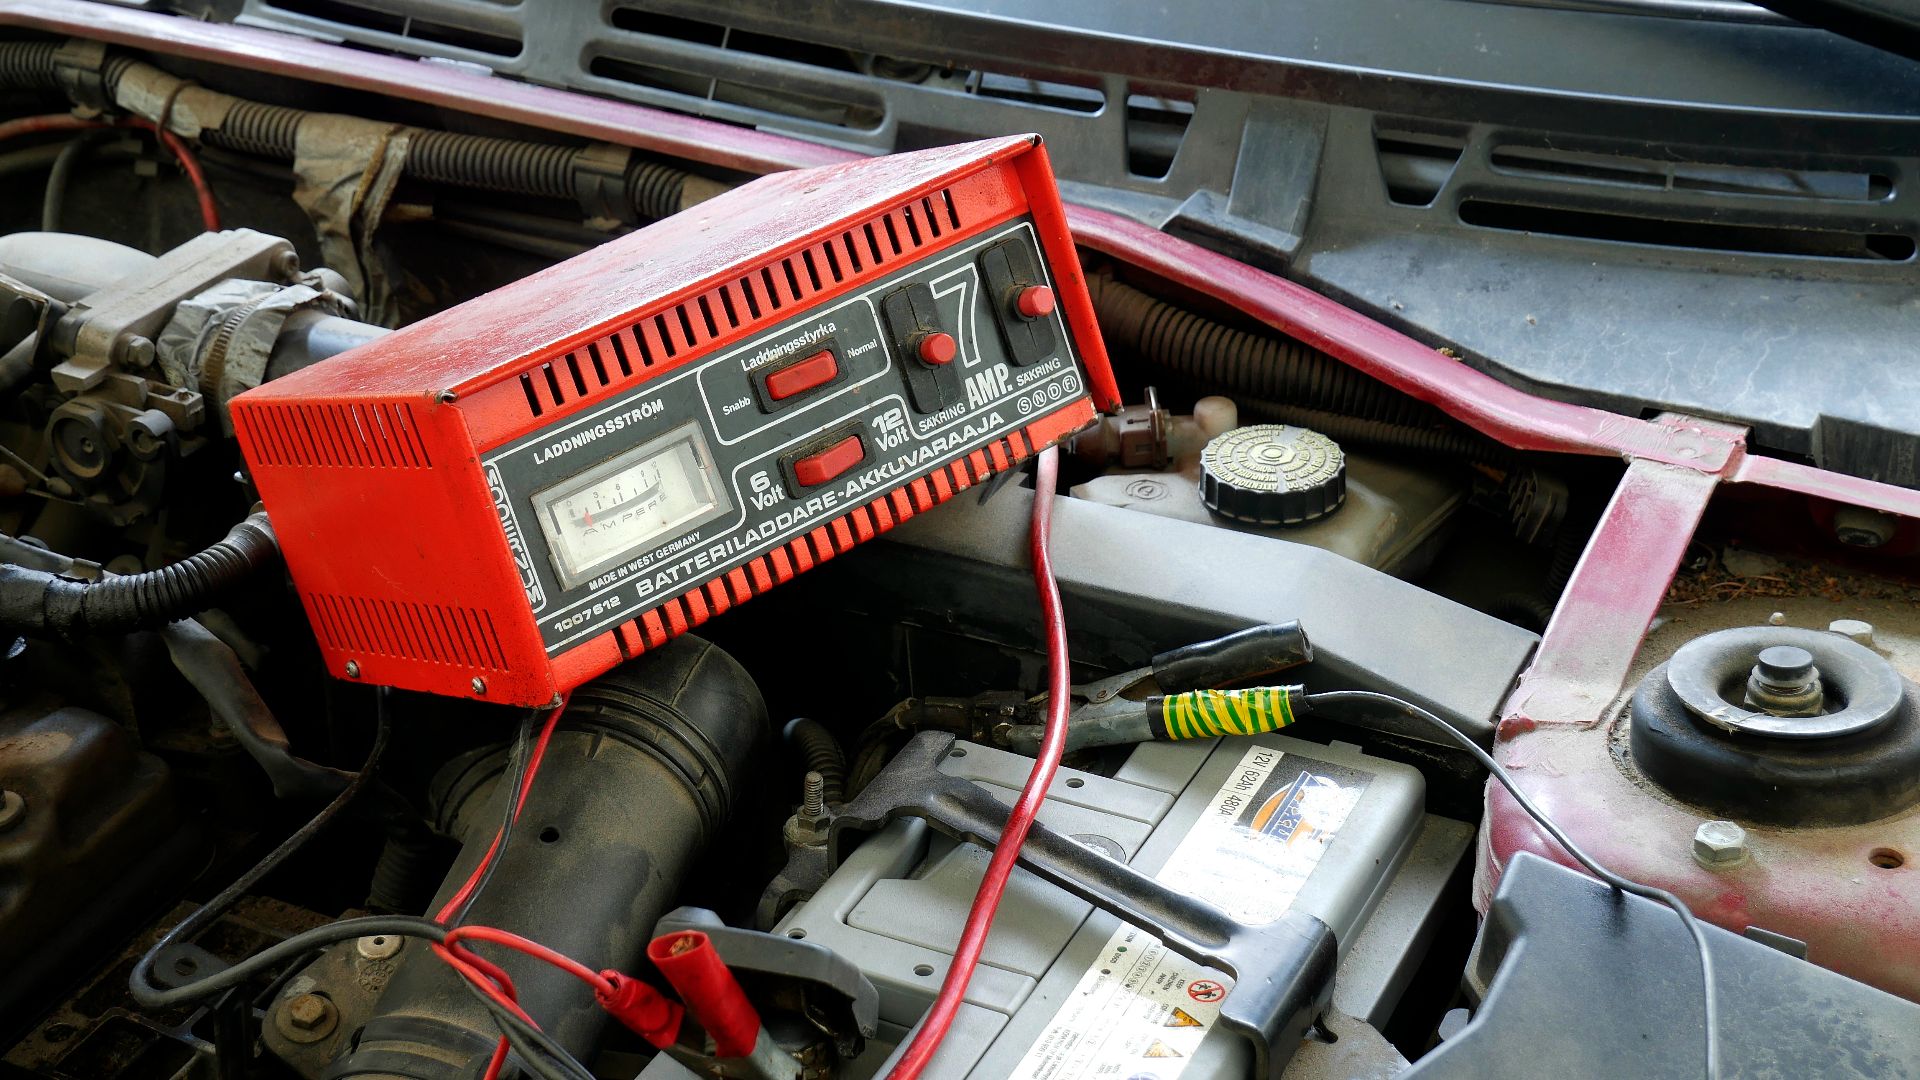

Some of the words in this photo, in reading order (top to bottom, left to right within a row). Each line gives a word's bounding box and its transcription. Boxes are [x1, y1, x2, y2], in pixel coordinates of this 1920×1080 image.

[929, 262, 980, 368] 7
[741, 321, 836, 372] Laddningsstyrka
[847, 339, 878, 358] Normal
[1016, 358, 1061, 386] SÄKRING
[965, 363, 1013, 410] AMP.
[722, 396, 751, 416] Snabb
[871, 407, 904, 433] 12
[918, 404, 965, 432] SÄKRING
[533, 399, 664, 465] LADDNINGSSTRÖM
[875, 427, 909, 452] Volt
[750, 471, 771, 492] 6
[1232, 478, 1278, 492] ATTENTION
[635, 411, 1004, 598] BATTERILADDARE-AKKUVARAAJA
[750, 484, 785, 512] Volt
[583, 493, 668, 537] AMPERE
[589, 569, 617, 591] MADE
[617, 565, 629, 580] IN
[628, 553, 655, 576] WEST
[656, 531, 701, 564] GERMANY
[554, 595, 621, 633] 1007612
[1252, 751, 1275, 769] 12V
[1239, 769, 1261, 792] 62Ah
